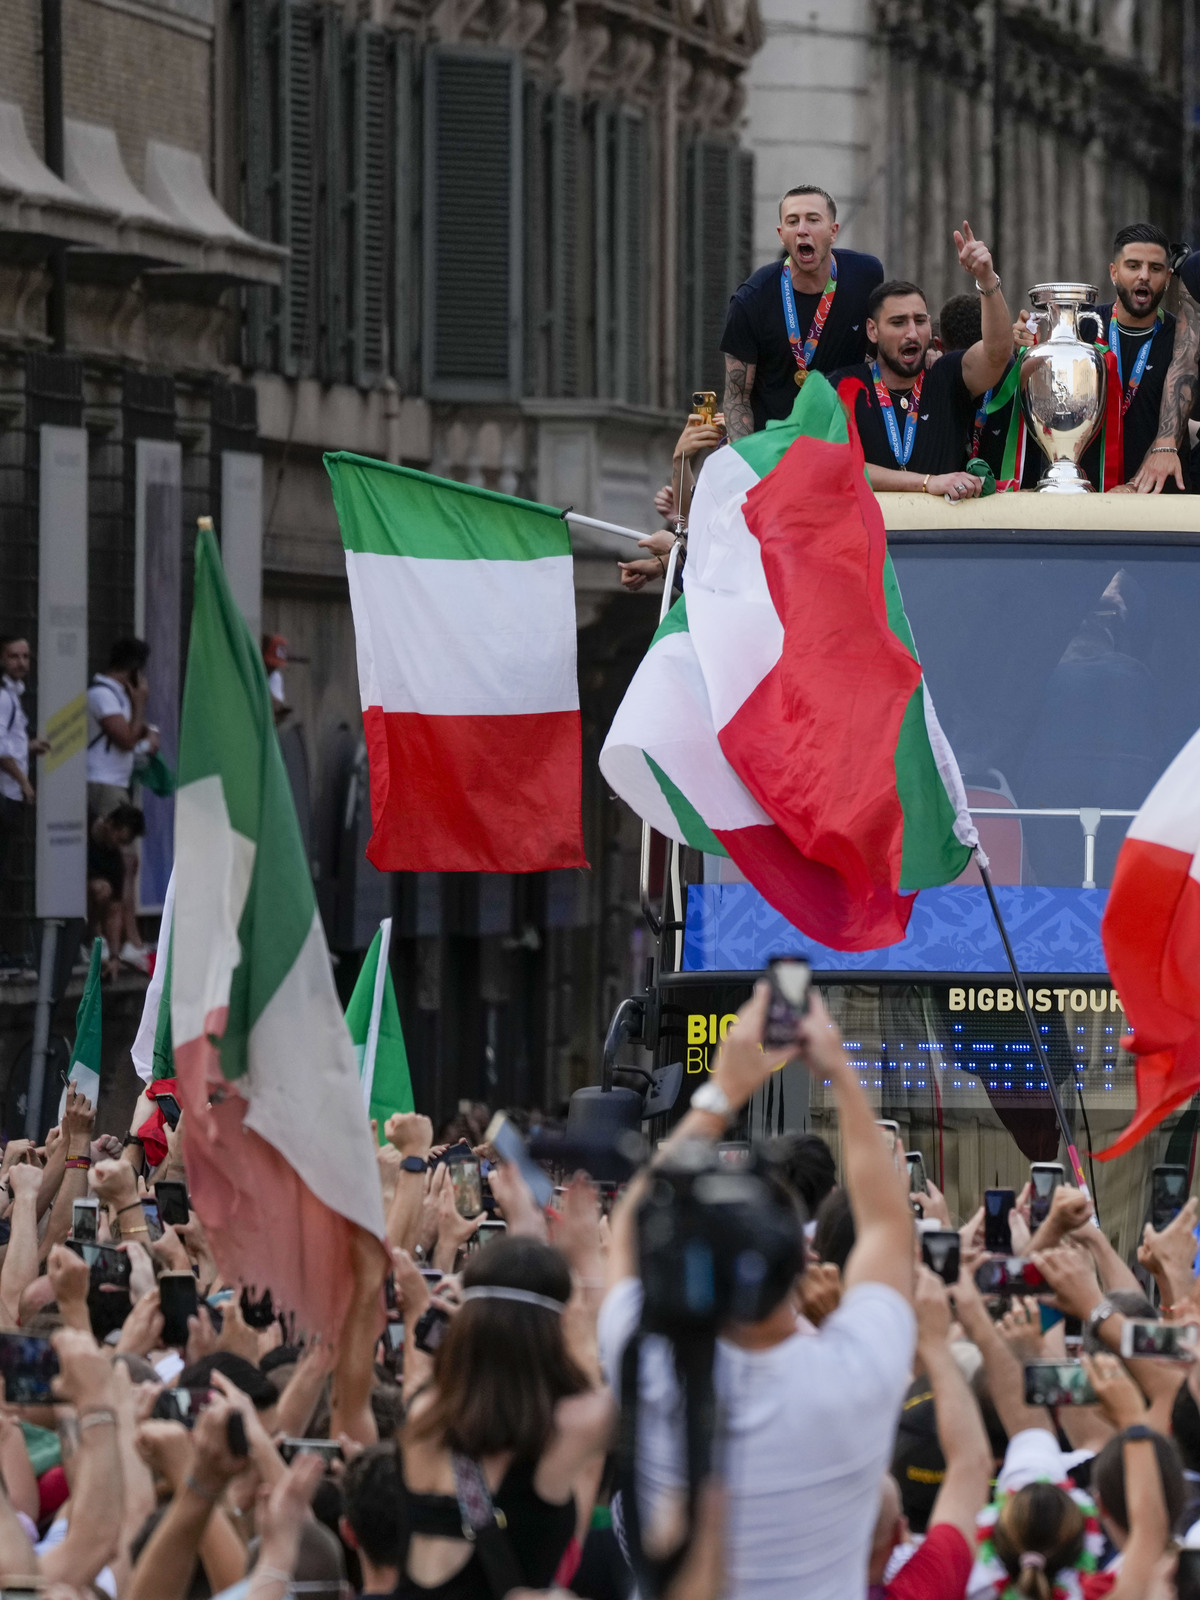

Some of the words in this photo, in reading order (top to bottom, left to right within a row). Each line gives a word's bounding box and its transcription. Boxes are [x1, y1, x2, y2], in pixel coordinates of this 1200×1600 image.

[1135, 359, 1145, 374] 2020
[889, 426, 897, 442] EURO
[948, 987, 1125, 1012] BIGBUSTOUR
[686, 1046, 722, 1074] BU
